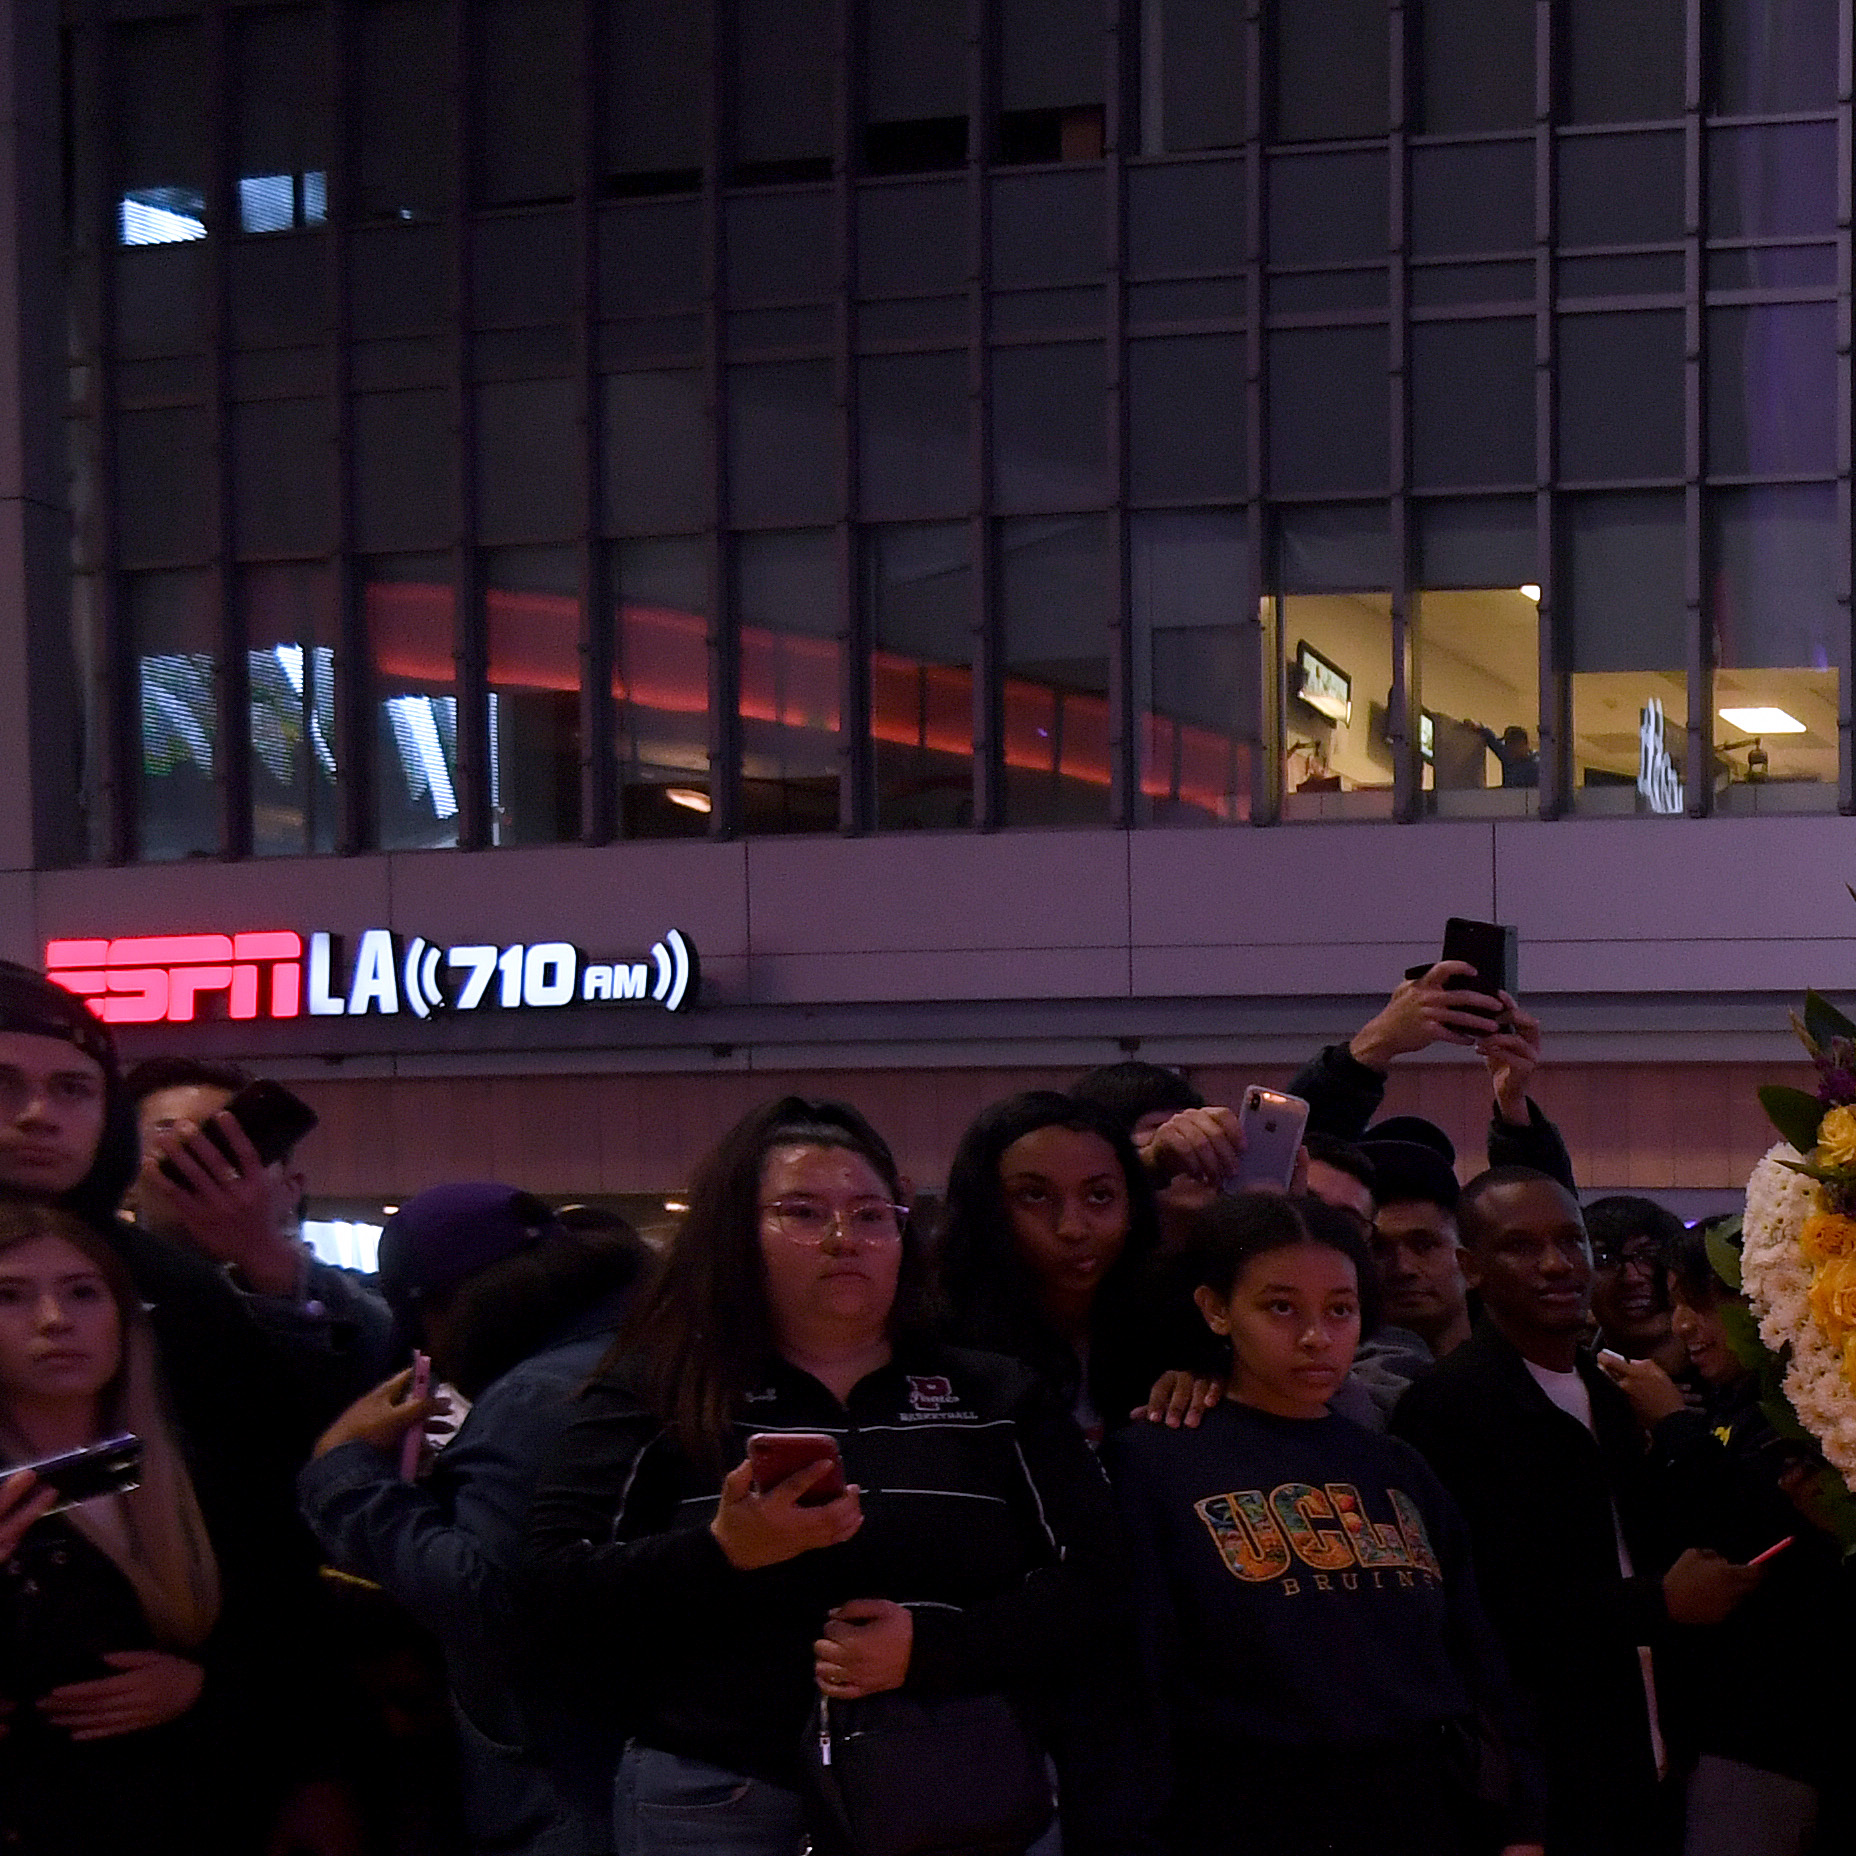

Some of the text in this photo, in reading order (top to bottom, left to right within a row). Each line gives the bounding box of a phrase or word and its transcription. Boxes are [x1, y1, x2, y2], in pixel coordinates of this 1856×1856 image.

[46, 928, 648, 1022] ESPN LA 710 AM
